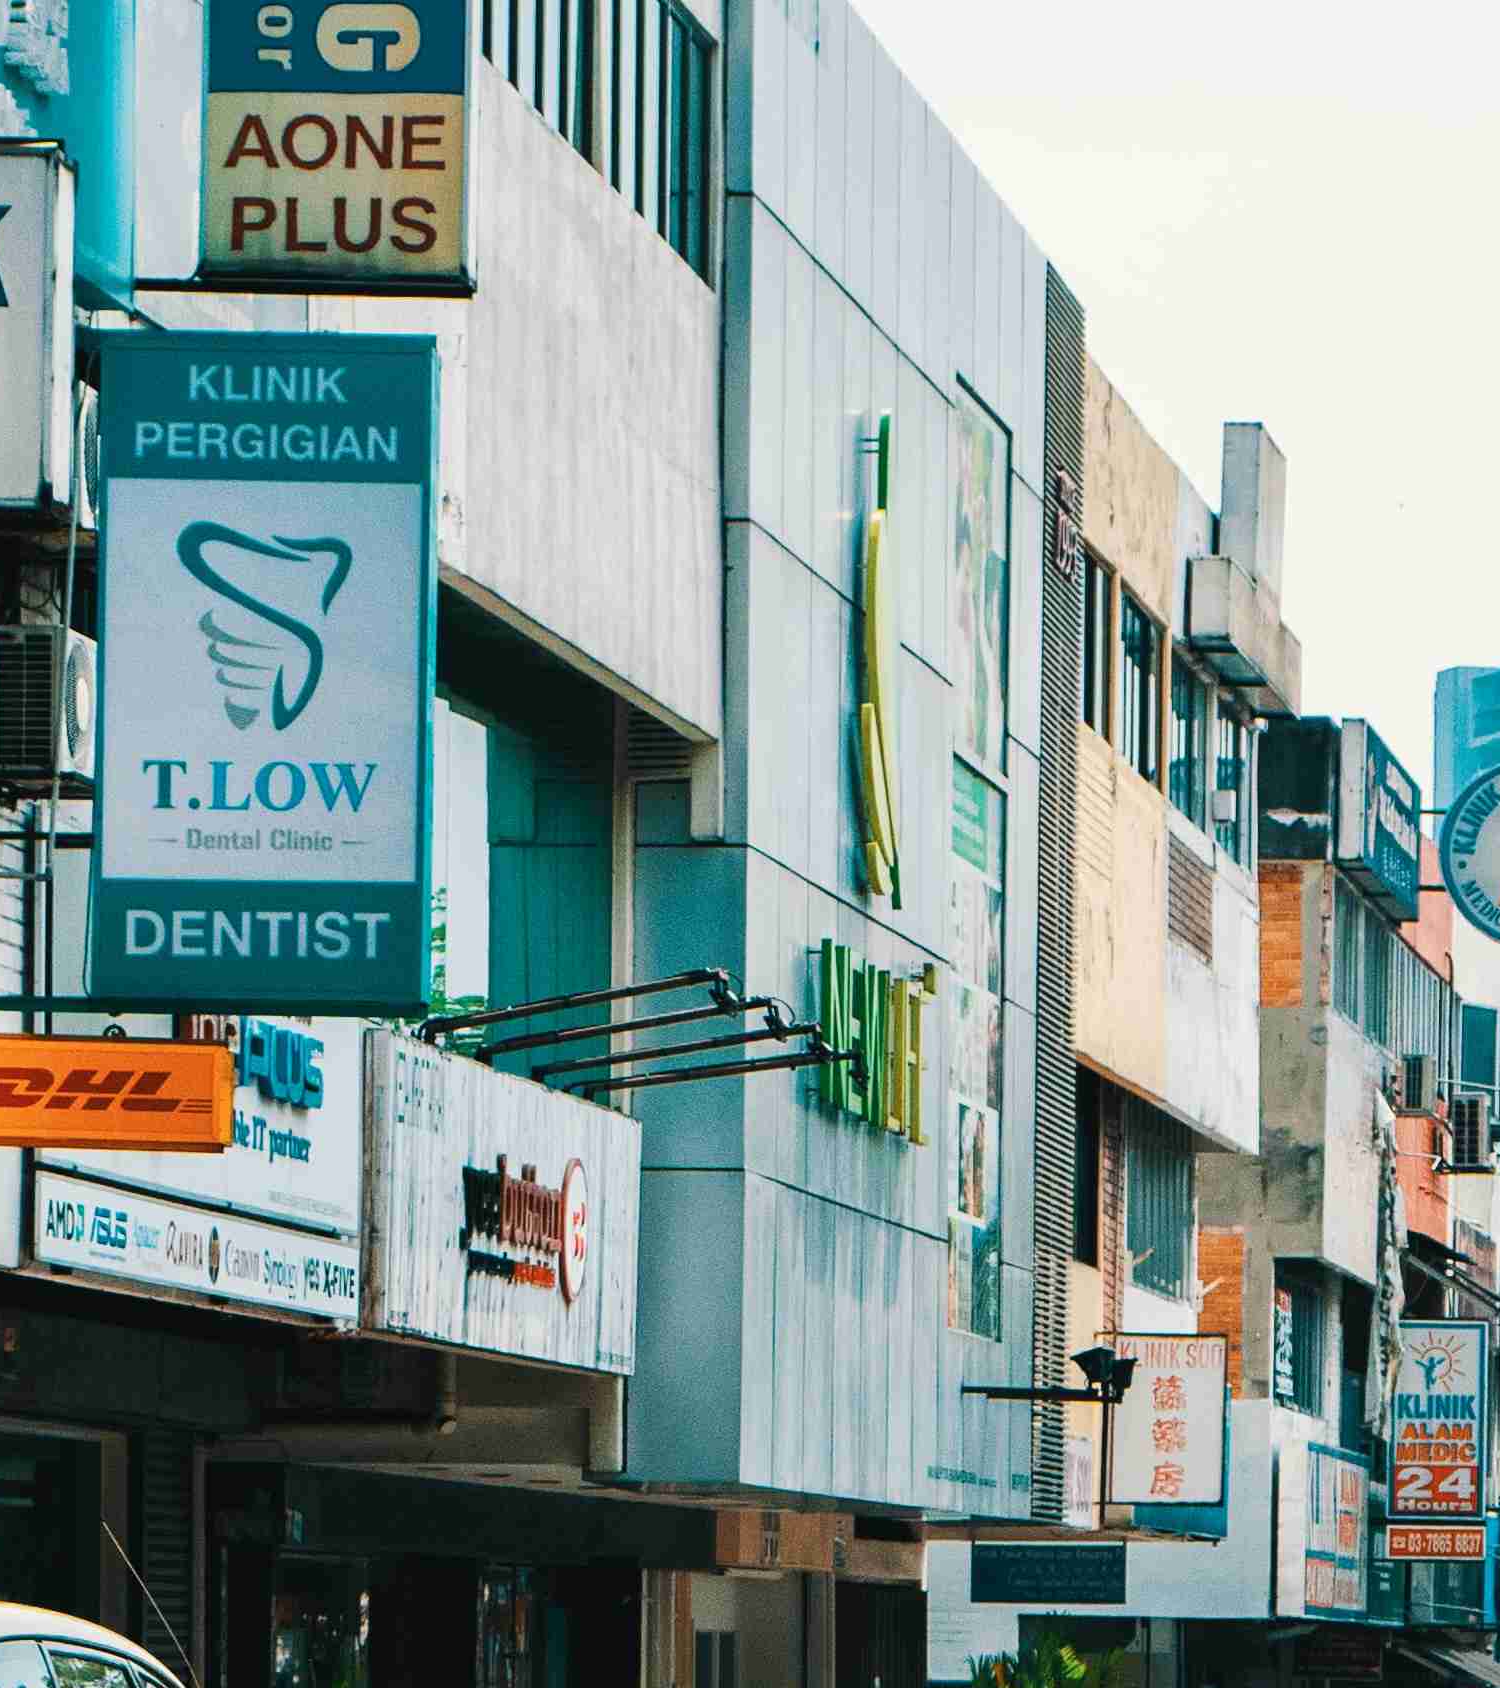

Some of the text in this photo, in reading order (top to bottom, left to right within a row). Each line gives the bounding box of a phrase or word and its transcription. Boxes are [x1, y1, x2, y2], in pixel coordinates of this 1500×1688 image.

[222, 114, 446, 171] AONE
[231, 196, 438, 254] PLUS
[187, 364, 349, 404] KLINIK
[134, 421, 398, 462] PERGIGIAN
[142, 759, 378, 813] T.LOW
[186, 827, 334, 852] Dental Clinic
[125, 909, 391, 959] DENTIST
[45, 1198, 76, 1240] AMD
[322, 1259, 355, 1299] X-FIVE
[1397, 1393, 1477, 1421] KLINIK
[1401, 1423, 1473, 1441] ALAM
[1395, 1442, 1477, 1464] MEDIC
[1396, 1466, 1477, 1499] 24
[1396, 1498, 1474, 1513] Hours
